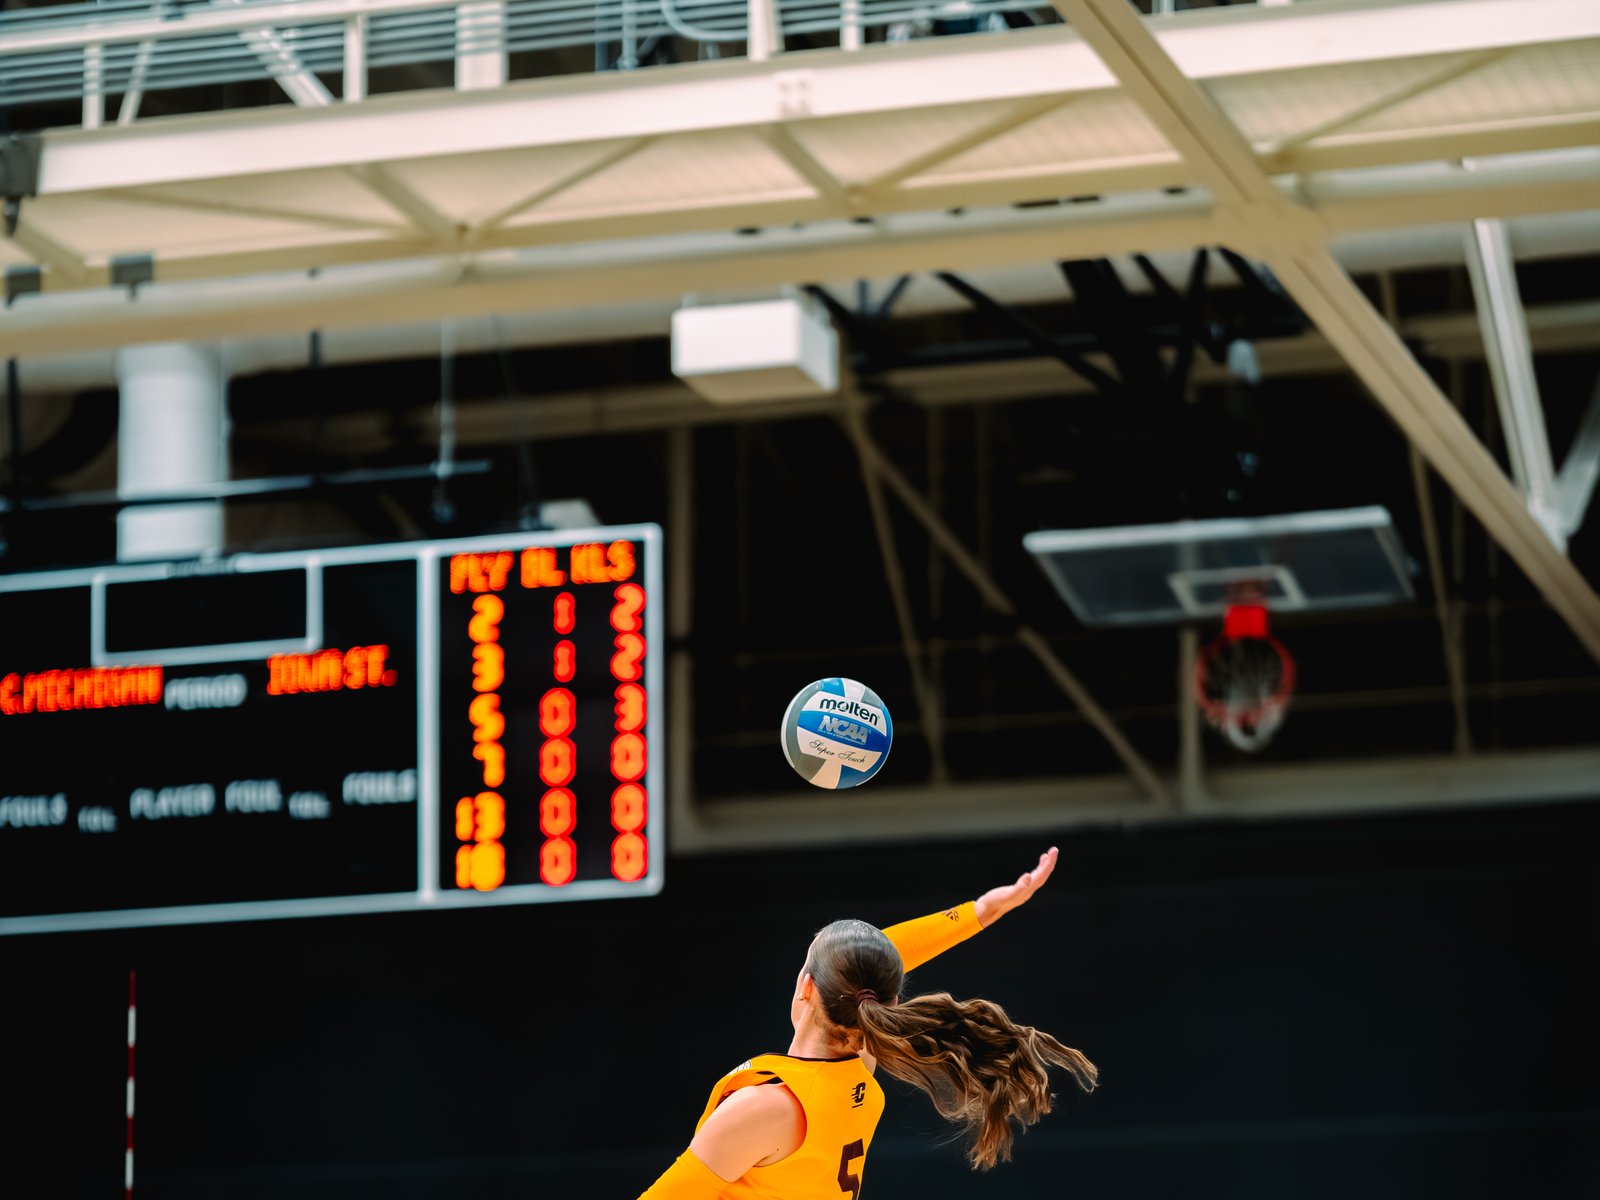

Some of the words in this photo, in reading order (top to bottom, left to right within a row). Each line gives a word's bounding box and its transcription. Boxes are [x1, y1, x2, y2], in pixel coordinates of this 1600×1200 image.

[468, 594, 504, 643] 2
[554, 592, 575, 634] 1
[610, 583, 646, 633] 2
[472, 641, 504, 692] 3
[554, 640, 575, 682] 1
[610, 632, 646, 682] 2
[469, 693, 505, 743] 5
[539, 687, 576, 739] 0
[614, 682, 646, 734] 3
[817, 714, 868, 743] NCAA
[820, 698, 879, 726] molten
[539, 736, 576, 788] 0
[610, 731, 648, 783] 0
[809, 739, 836, 756] Super
[838, 750, 865, 763] Touch
[540, 787, 576, 839] 0
[611, 782, 648, 834] 0
[540, 835, 576, 888] 0
[611, 830, 648, 883] 0
